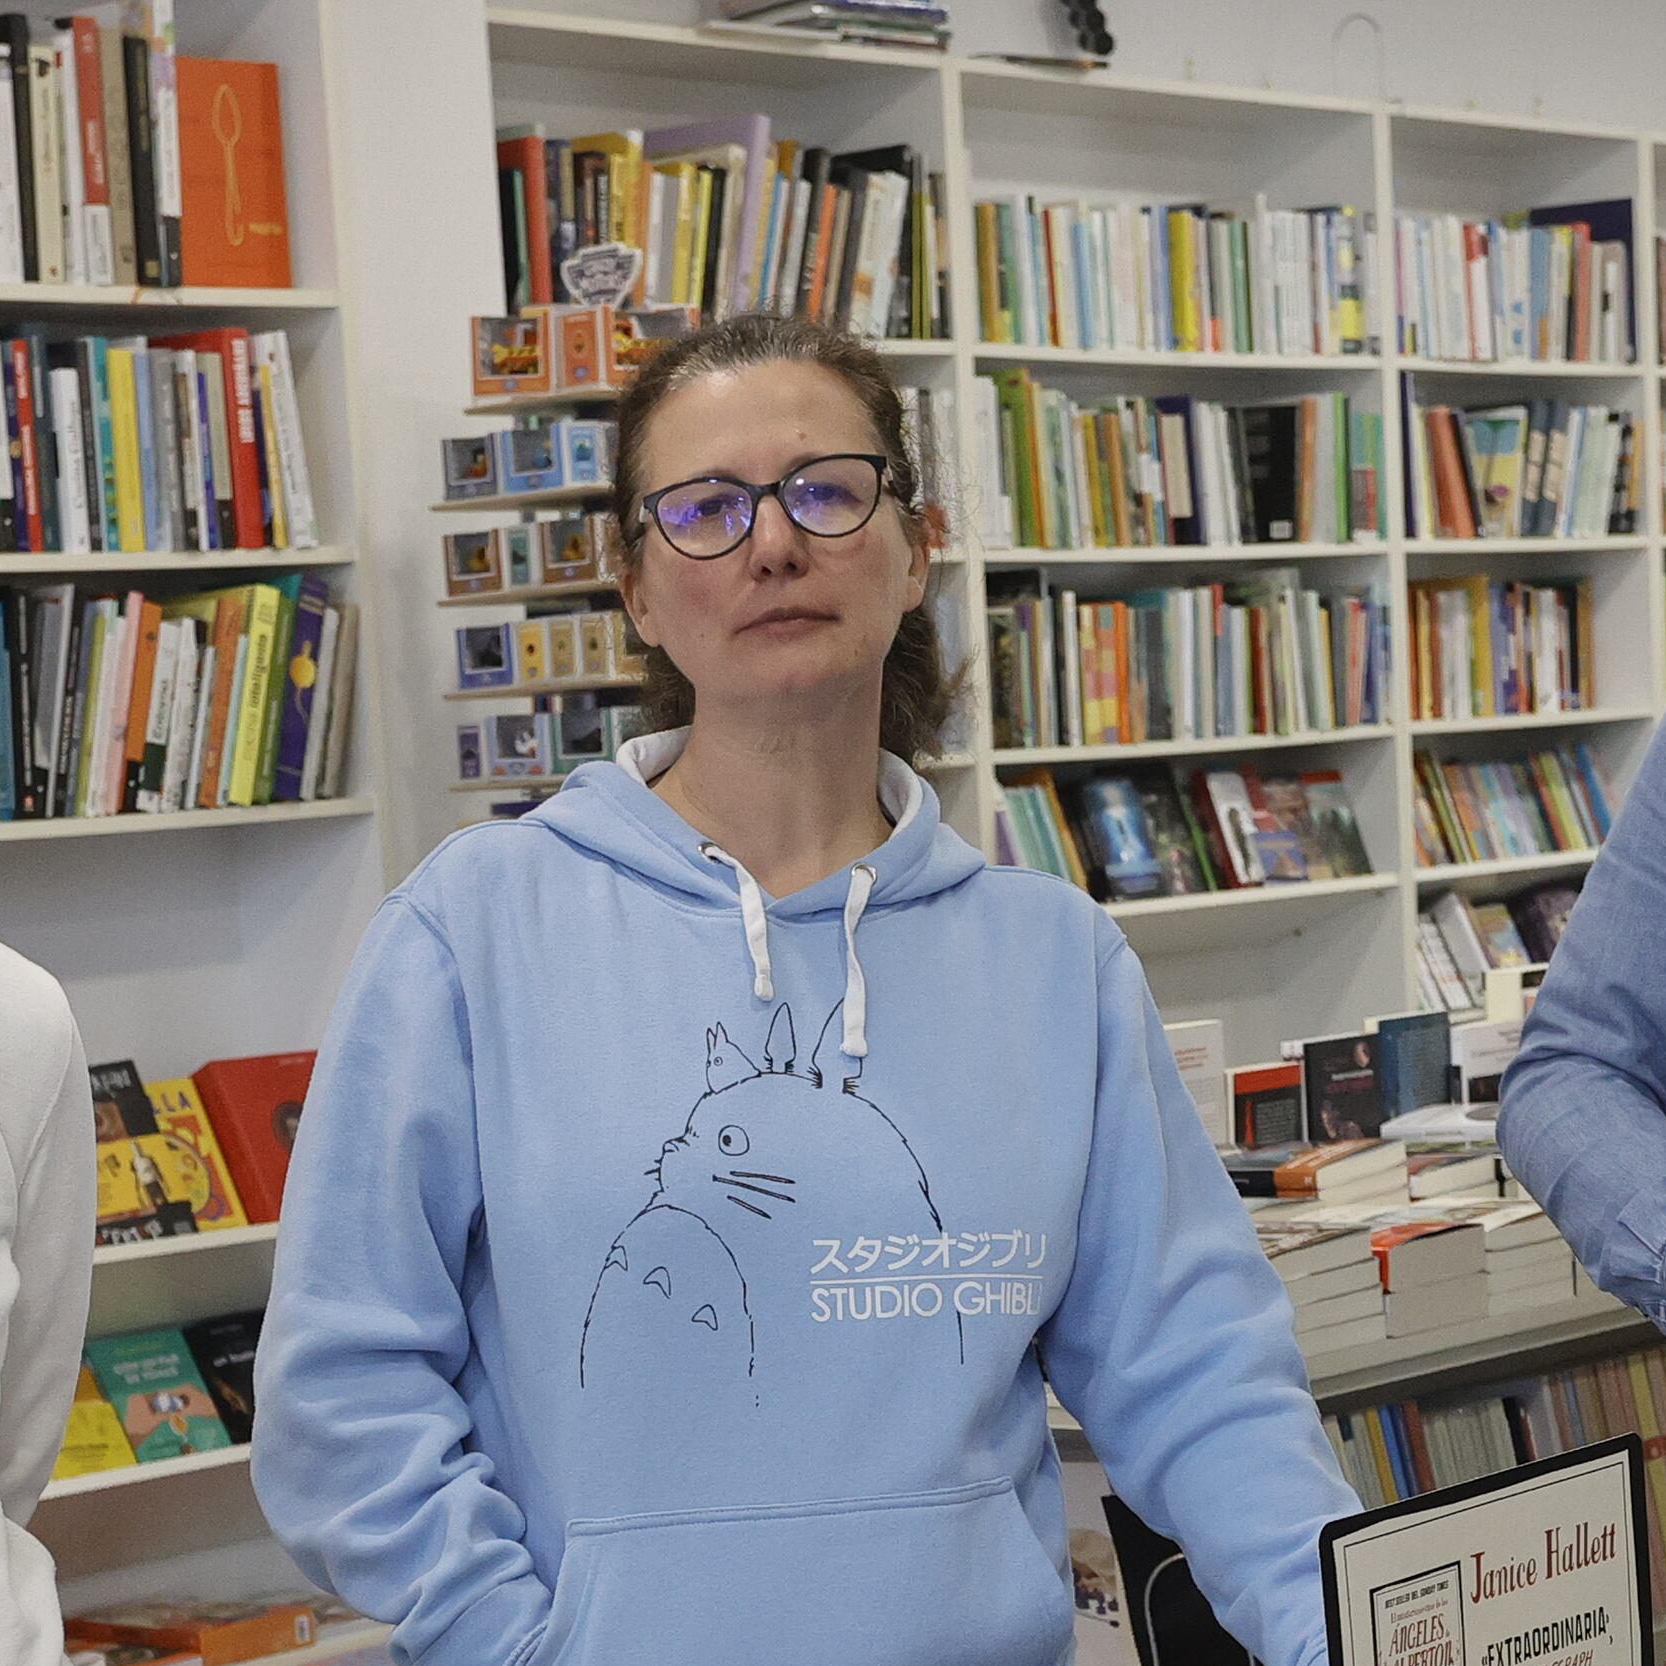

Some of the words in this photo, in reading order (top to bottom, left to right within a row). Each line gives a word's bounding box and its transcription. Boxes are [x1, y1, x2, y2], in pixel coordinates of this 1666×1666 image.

[811, 1229, 1046, 1273] スタジオジブリ
[810, 1283, 941, 1322] STUDIO
[1470, 1552, 1537, 1604] Janice
[1545, 1522, 1616, 1579] Hallett
[1389, 1613, 1444, 1656] ÁNGELES
